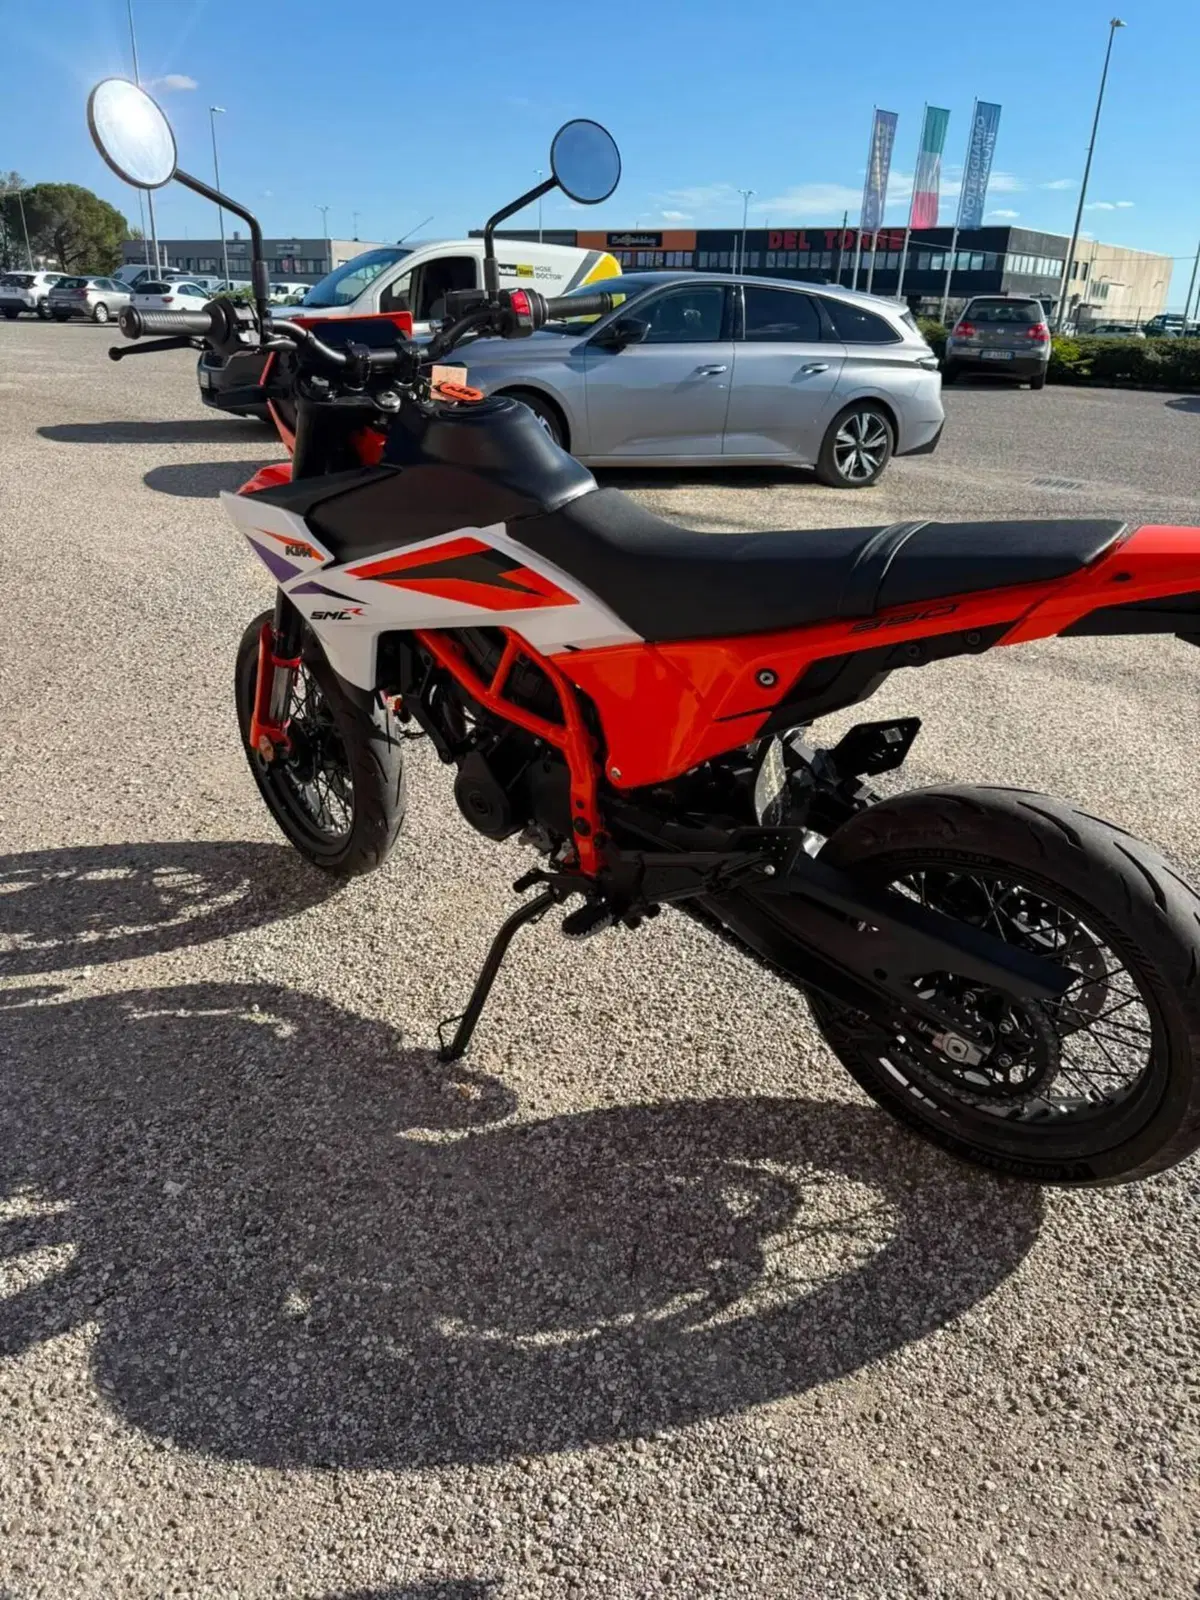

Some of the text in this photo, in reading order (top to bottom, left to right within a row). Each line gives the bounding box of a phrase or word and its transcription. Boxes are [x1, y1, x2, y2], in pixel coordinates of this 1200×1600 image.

[963, 115, 985, 220] NOLEGGIAMO
[768, 230, 810, 250] DEL
[534, 265, 552, 273] HOSE
[535, 272, 563, 280] DOCTOR
[446, 386, 478, 397] KTM
[285, 545, 312, 558] KTM
